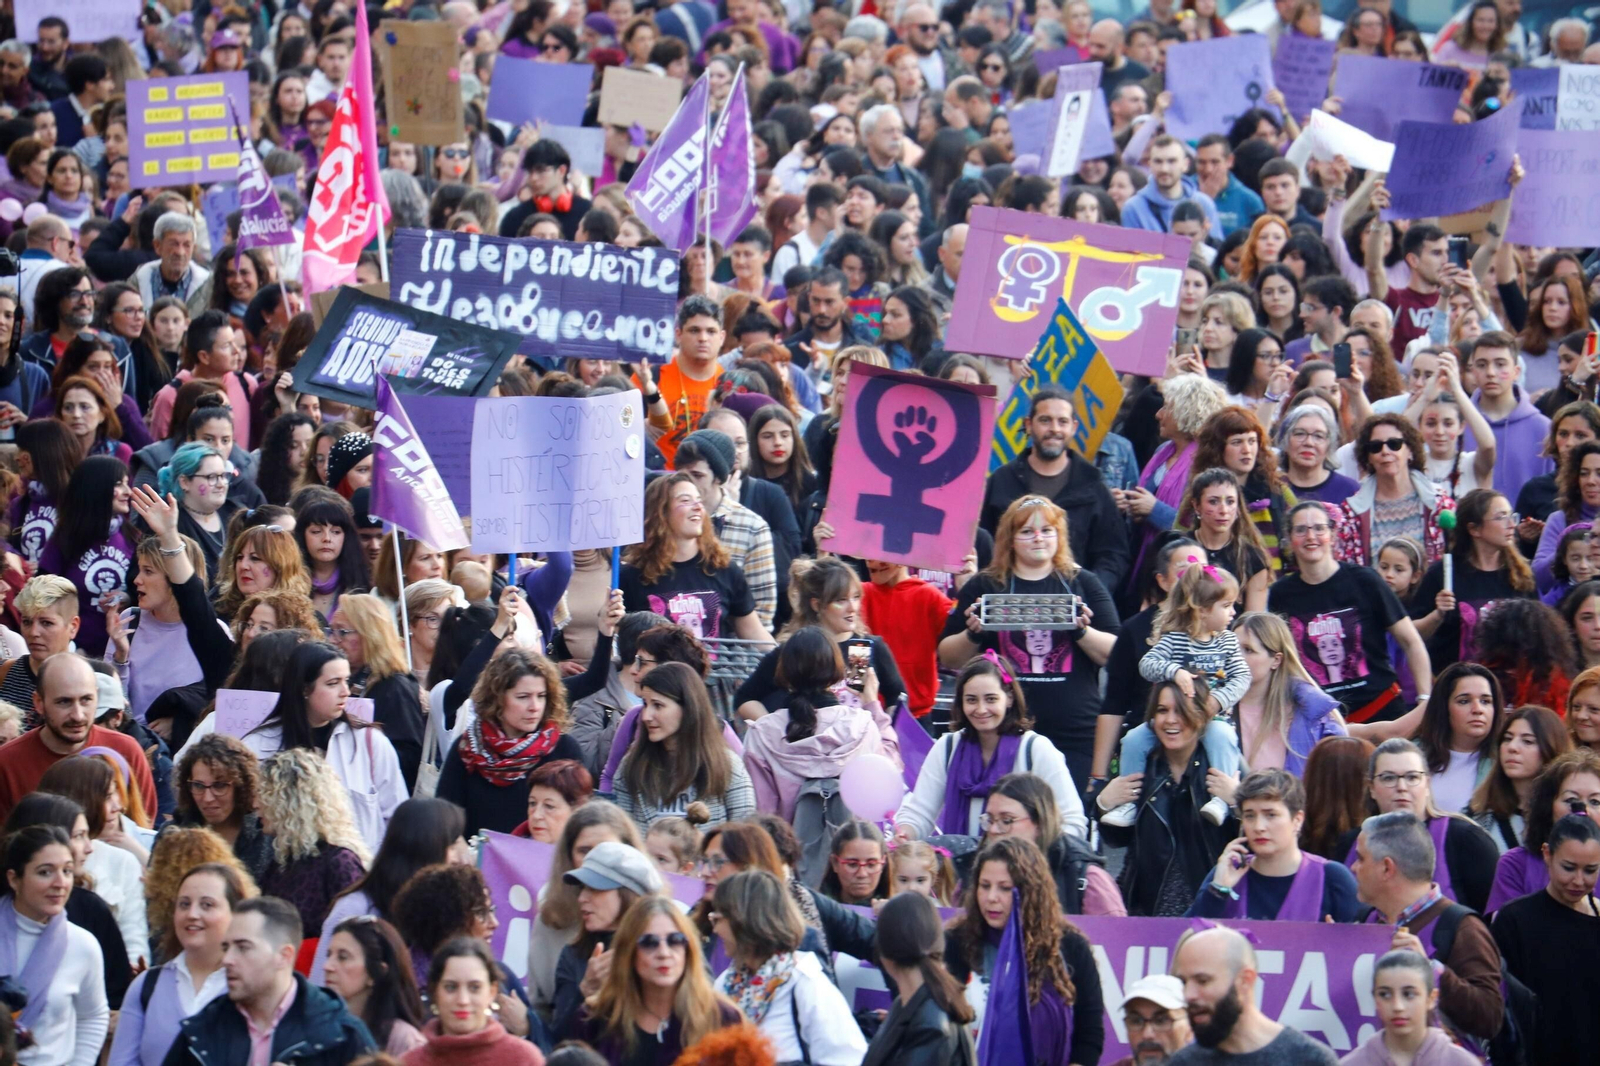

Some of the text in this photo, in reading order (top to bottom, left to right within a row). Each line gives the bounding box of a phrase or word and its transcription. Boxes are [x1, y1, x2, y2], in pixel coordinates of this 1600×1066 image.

[420, 229, 681, 294] independiente
[488, 403, 519, 440] NO
[547, 404, 615, 441] SOMOS
[512, 494, 638, 545] HISTÓRICAS
[78, 548, 101, 572] GIRL
